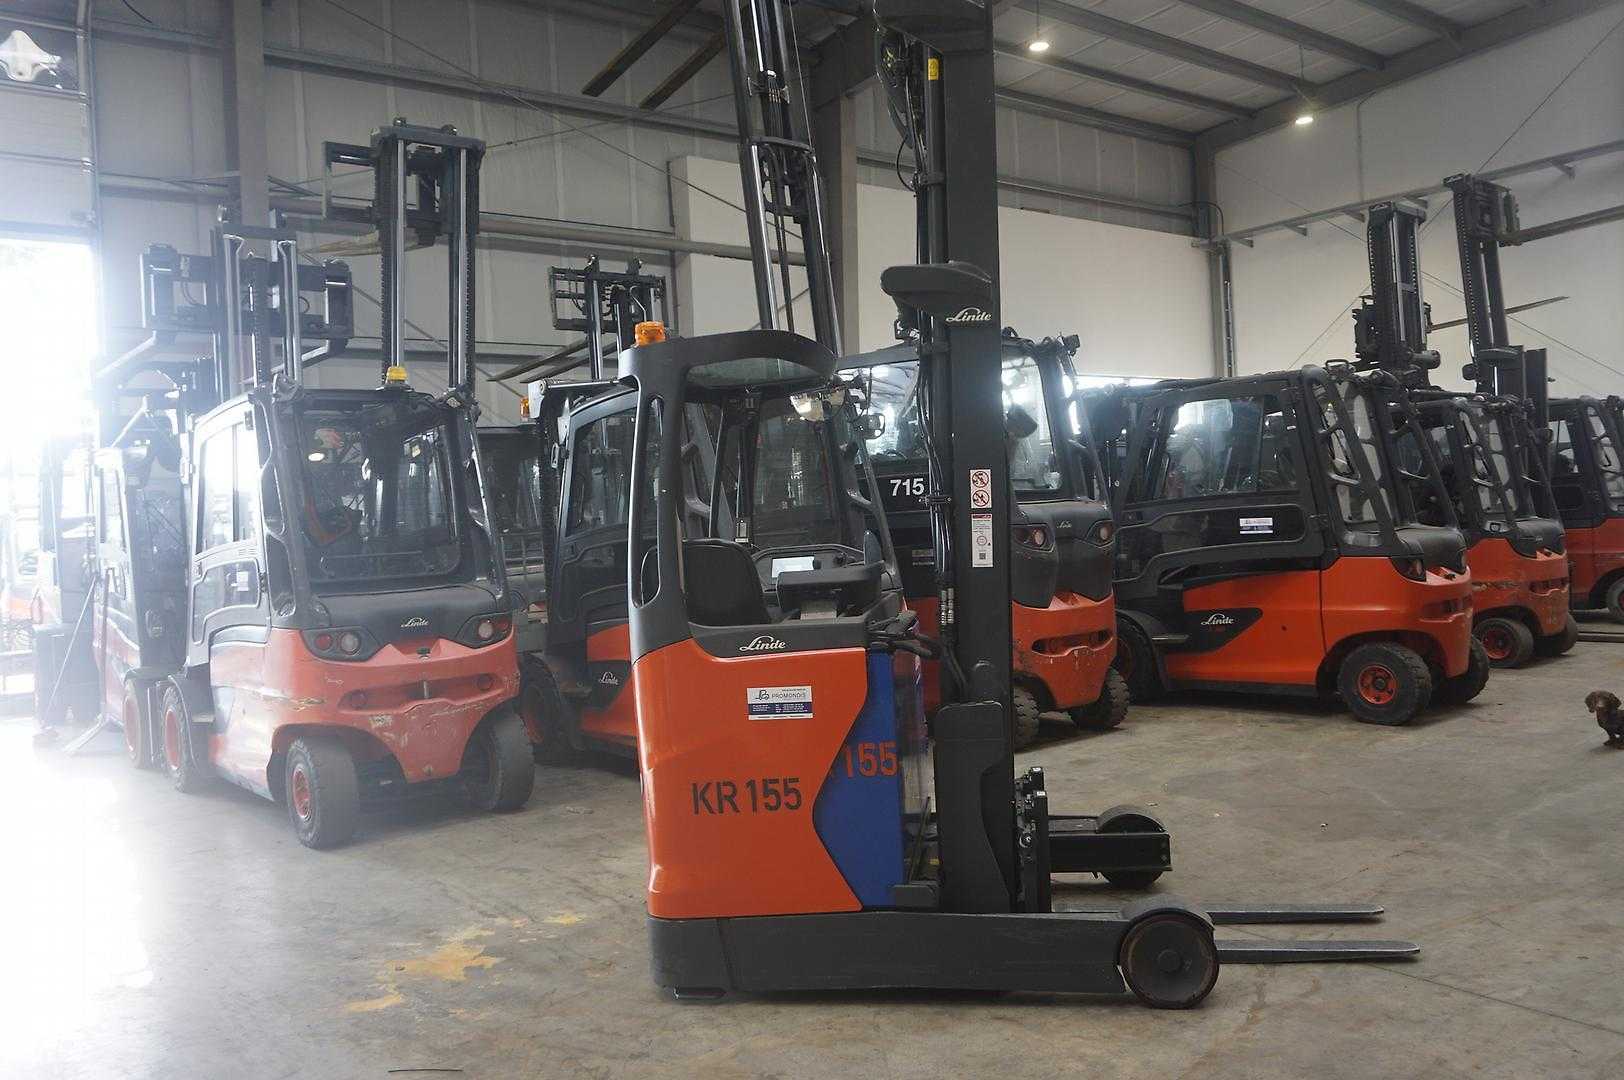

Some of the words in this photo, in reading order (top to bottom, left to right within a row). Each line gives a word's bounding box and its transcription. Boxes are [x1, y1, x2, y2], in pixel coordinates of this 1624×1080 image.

[945, 307, 992, 322] Linde
[890, 477, 925, 496] 715
[1200, 613, 1235, 625] Linde
[739, 635, 787, 651] Linde
[843, 741, 898, 778] 155
[691, 780, 740, 815] KR
[745, 777, 802, 814] 155
